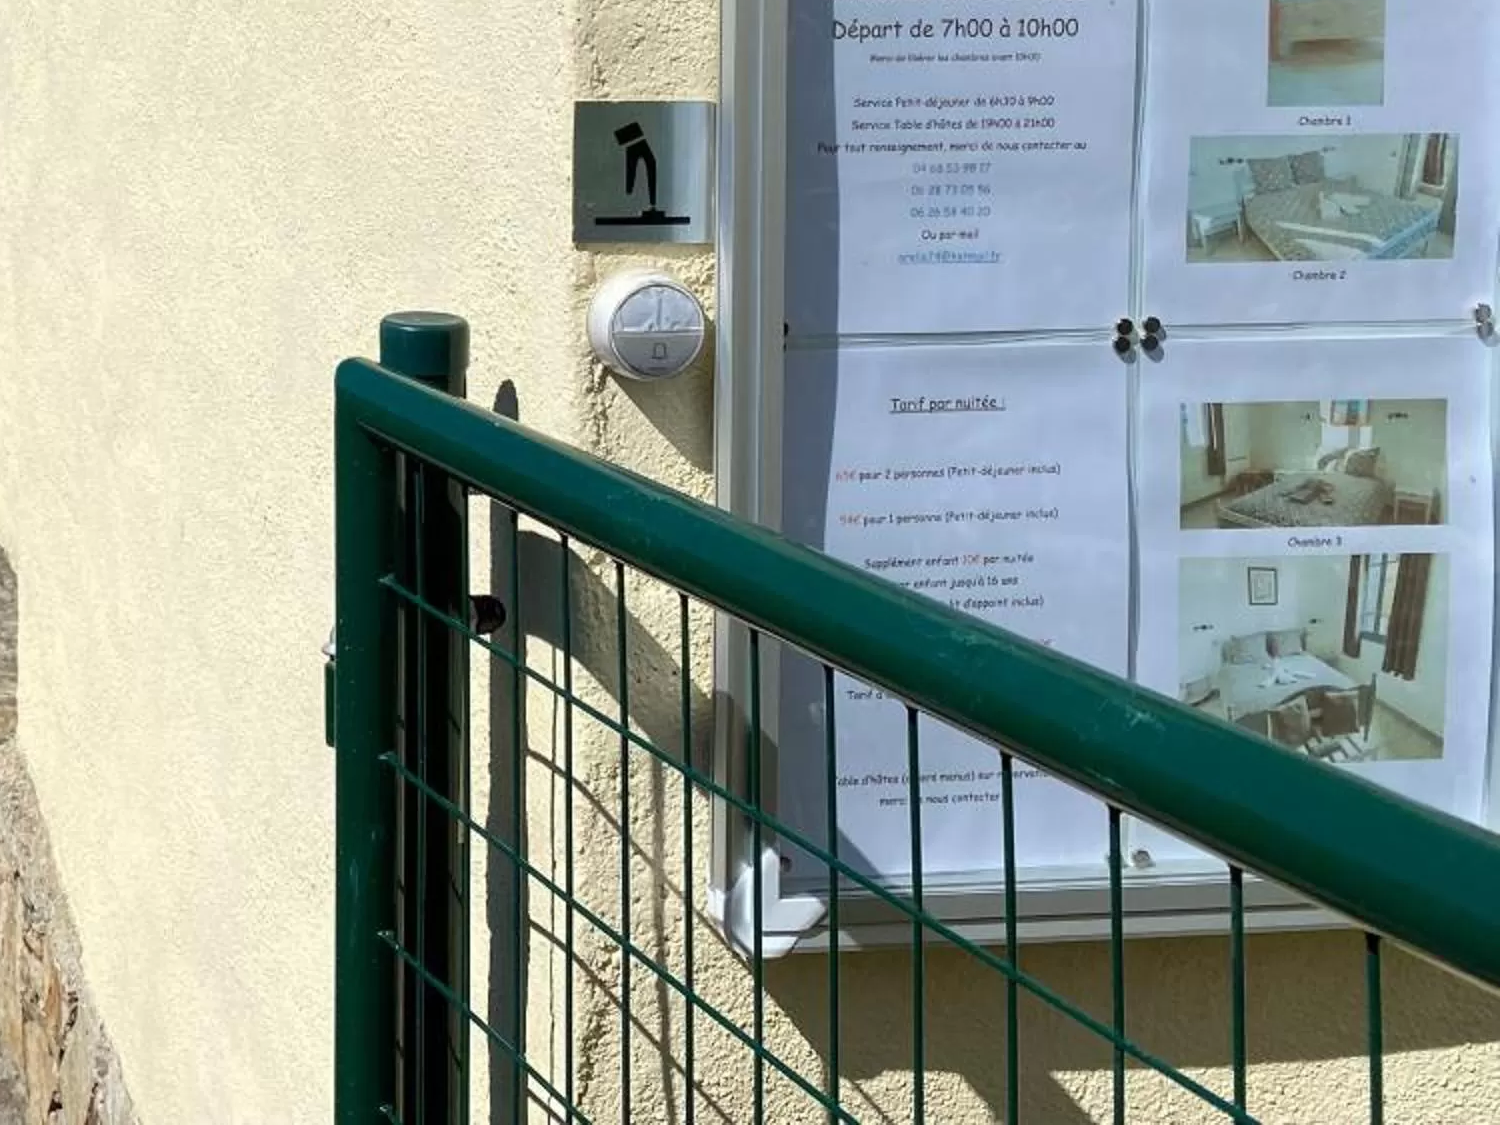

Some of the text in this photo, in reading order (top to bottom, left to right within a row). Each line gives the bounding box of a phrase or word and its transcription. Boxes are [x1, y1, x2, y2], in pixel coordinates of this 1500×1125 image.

[832, 17, 1079, 43] Départ de 7h00 à 10h00
[853, 97, 894, 108] Service
[973, 96, 987, 108] de
[852, 119, 891, 130] Service
[894, 118, 923, 130] Table
[965, 118, 978, 130] de
[1298, 115, 1342, 126] Chambre
[817, 141, 839, 155] Pour
[845, 141, 865, 153] tout
[949, 141, 978, 152] merci
[981, 140, 993, 152] de
[996, 141, 1019, 151] nous
[1021, 140, 1072, 151] contacter
[1074, 141, 1087, 151] au
[921, 228, 937, 241] Ou
[1293, 269, 1337, 280] Chambre
[890, 395, 925, 412] Tarif
[929, 398, 952, 413] par
[955, 394, 997, 409] nuitée
[859, 472, 883, 484] pour
[893, 467, 945, 481] personnes
[863, 516, 887, 528] pour
[1288, 536, 1332, 548] Chambre
[925, 555, 959, 567] enfant
[983, 555, 1000, 567] par
[913, 578, 947, 588] enfant
[845, 689, 873, 701] Tarif
[837, 775, 860, 786] able
[925, 794, 949, 804] nous
[951, 791, 1000, 805] contacter
